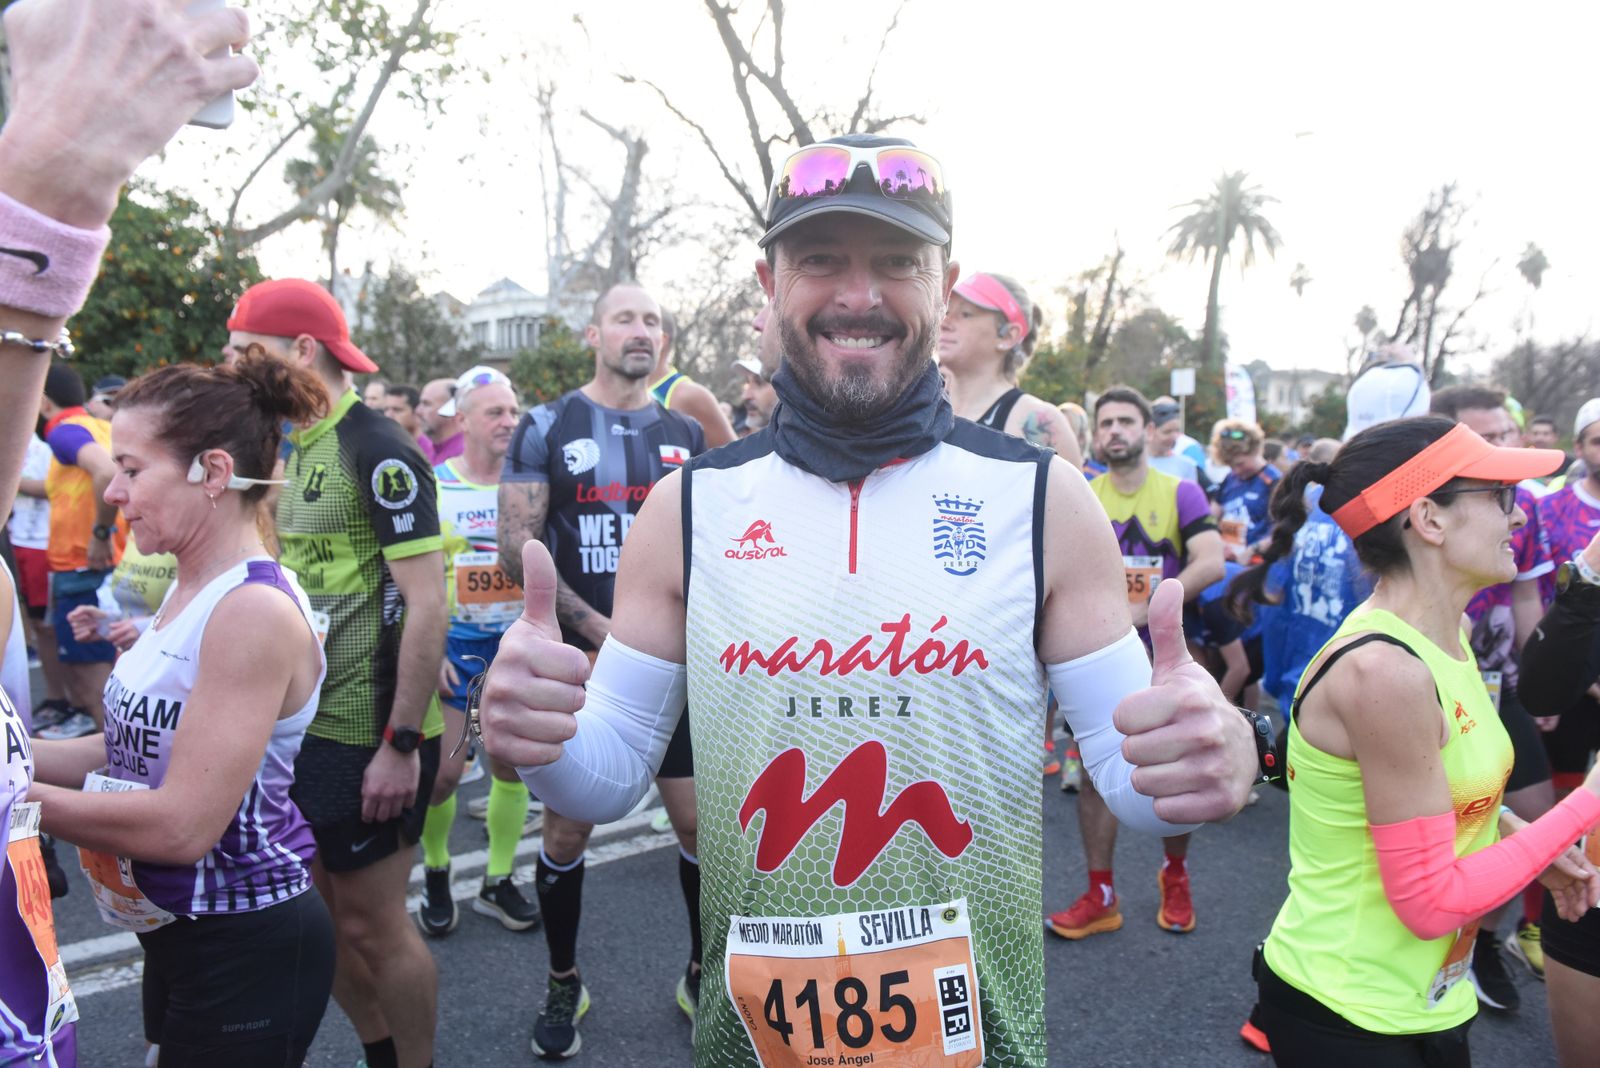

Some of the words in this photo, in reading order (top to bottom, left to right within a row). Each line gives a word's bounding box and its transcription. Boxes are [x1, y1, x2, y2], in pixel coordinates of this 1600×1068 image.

[578, 513, 616, 546] WE
[578, 546, 622, 574] TOG
[720, 613, 988, 677] maratón
[785, 696, 912, 718] JEREZ
[113, 748, 149, 777] CLUB
[738, 922, 769, 944] MEDIO
[772, 921, 823, 946] MARATÓN
[858, 907, 934, 947] SEVILLA
[763, 969, 917, 1050] 4185
[806, 1055, 834, 1067] Jose
[838, 1052, 874, 1068] Ángel
